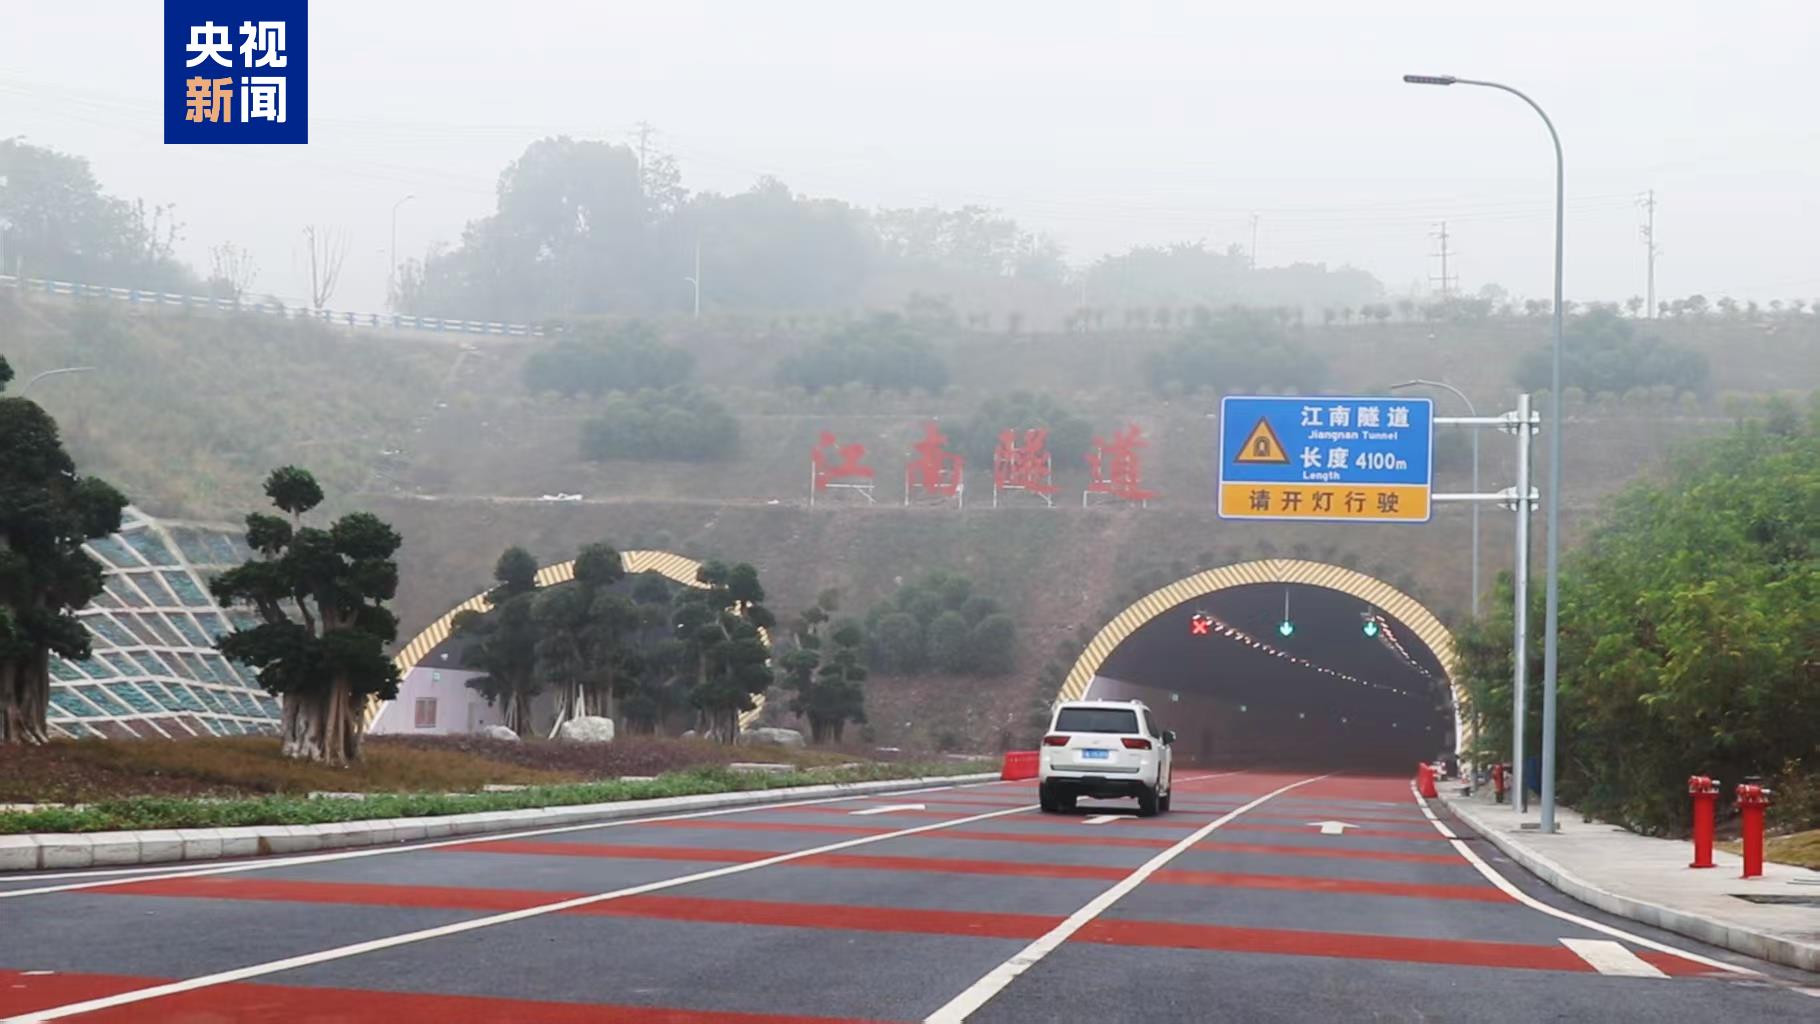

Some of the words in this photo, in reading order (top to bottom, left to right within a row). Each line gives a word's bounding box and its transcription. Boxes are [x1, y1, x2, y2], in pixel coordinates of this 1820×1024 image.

[1301, 405, 1410, 428] 江南隧道
[1308, 430, 1358, 442] Jiangnan
[1363, 431, 1398, 440] Tunnel
[812, 421, 1164, 500] 江南隧道
[1300, 446, 1349, 469] 长度
[1355, 453, 1407, 470] 4100m
[1303, 471, 1340, 482] Length
[1249, 489, 1399, 513] 请开灯行驶
